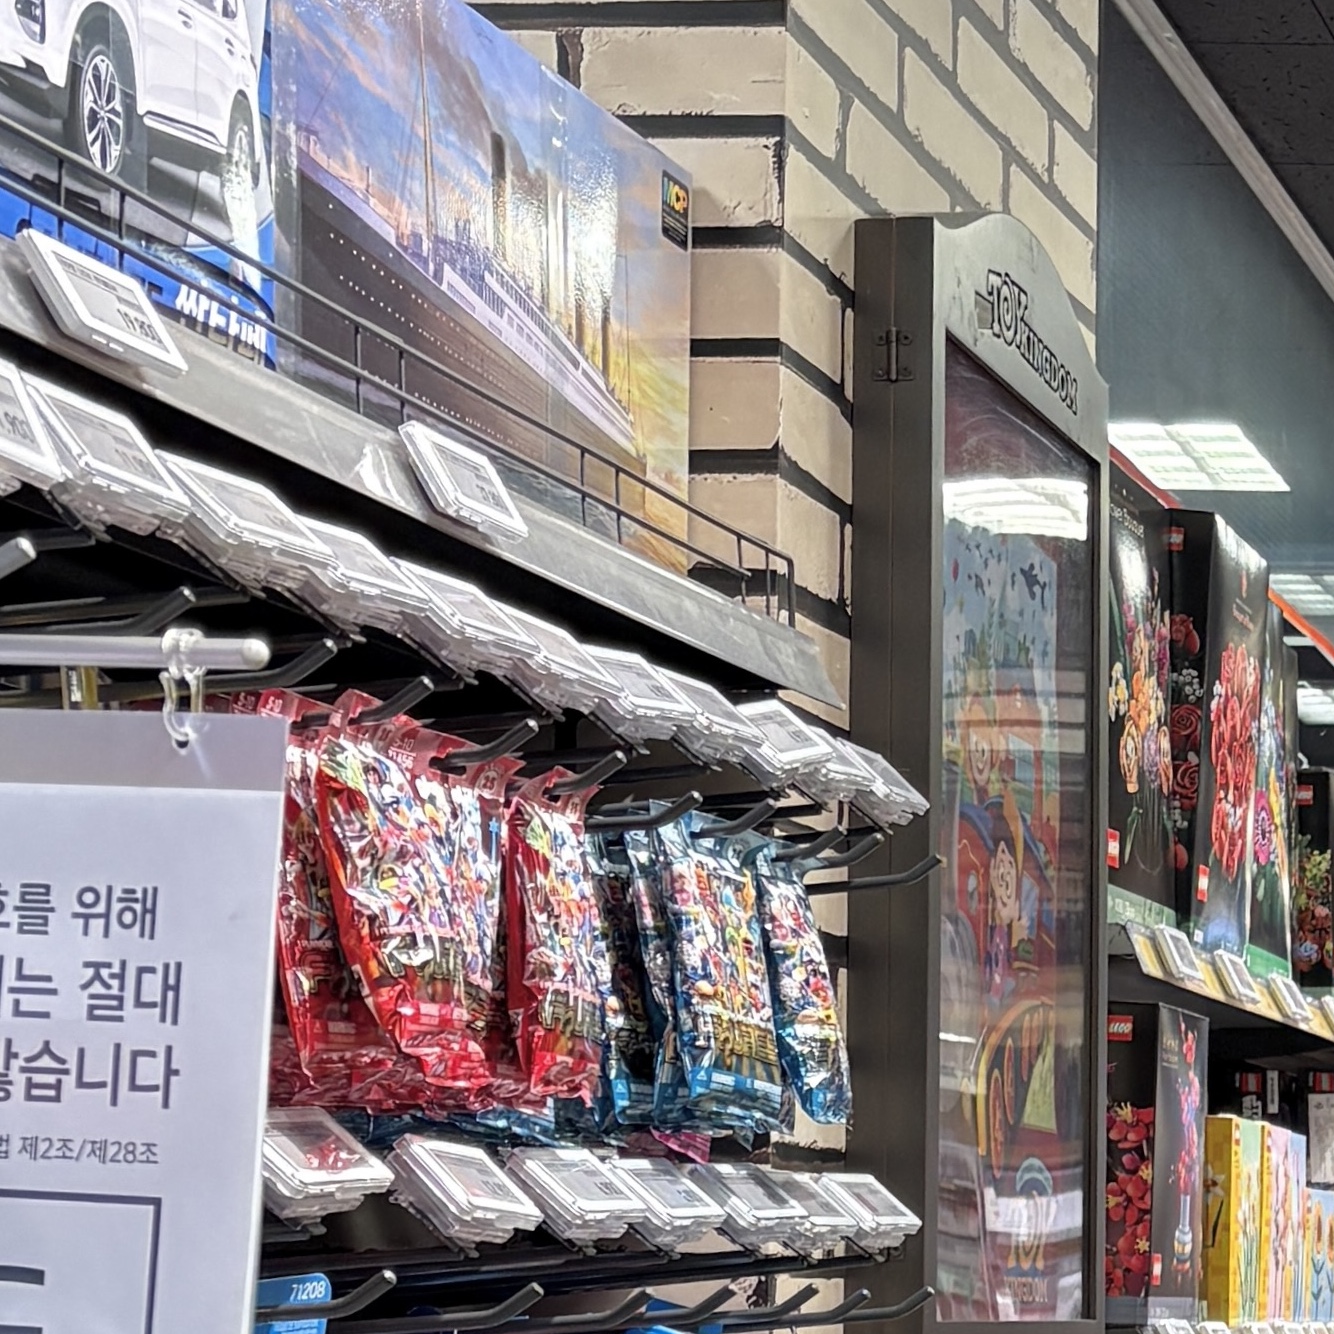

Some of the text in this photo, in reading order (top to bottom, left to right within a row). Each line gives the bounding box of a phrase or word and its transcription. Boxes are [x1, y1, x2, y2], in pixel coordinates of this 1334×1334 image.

[986, 269, 1078, 415] TOY KINGDOM
[71, 884, 160, 941] 위해
[0, 954, 184, 1027] 는 절대
[17, 1133, 161, 1167] 제2조/제28조
[289, 1279, 327, 1302] 71208
